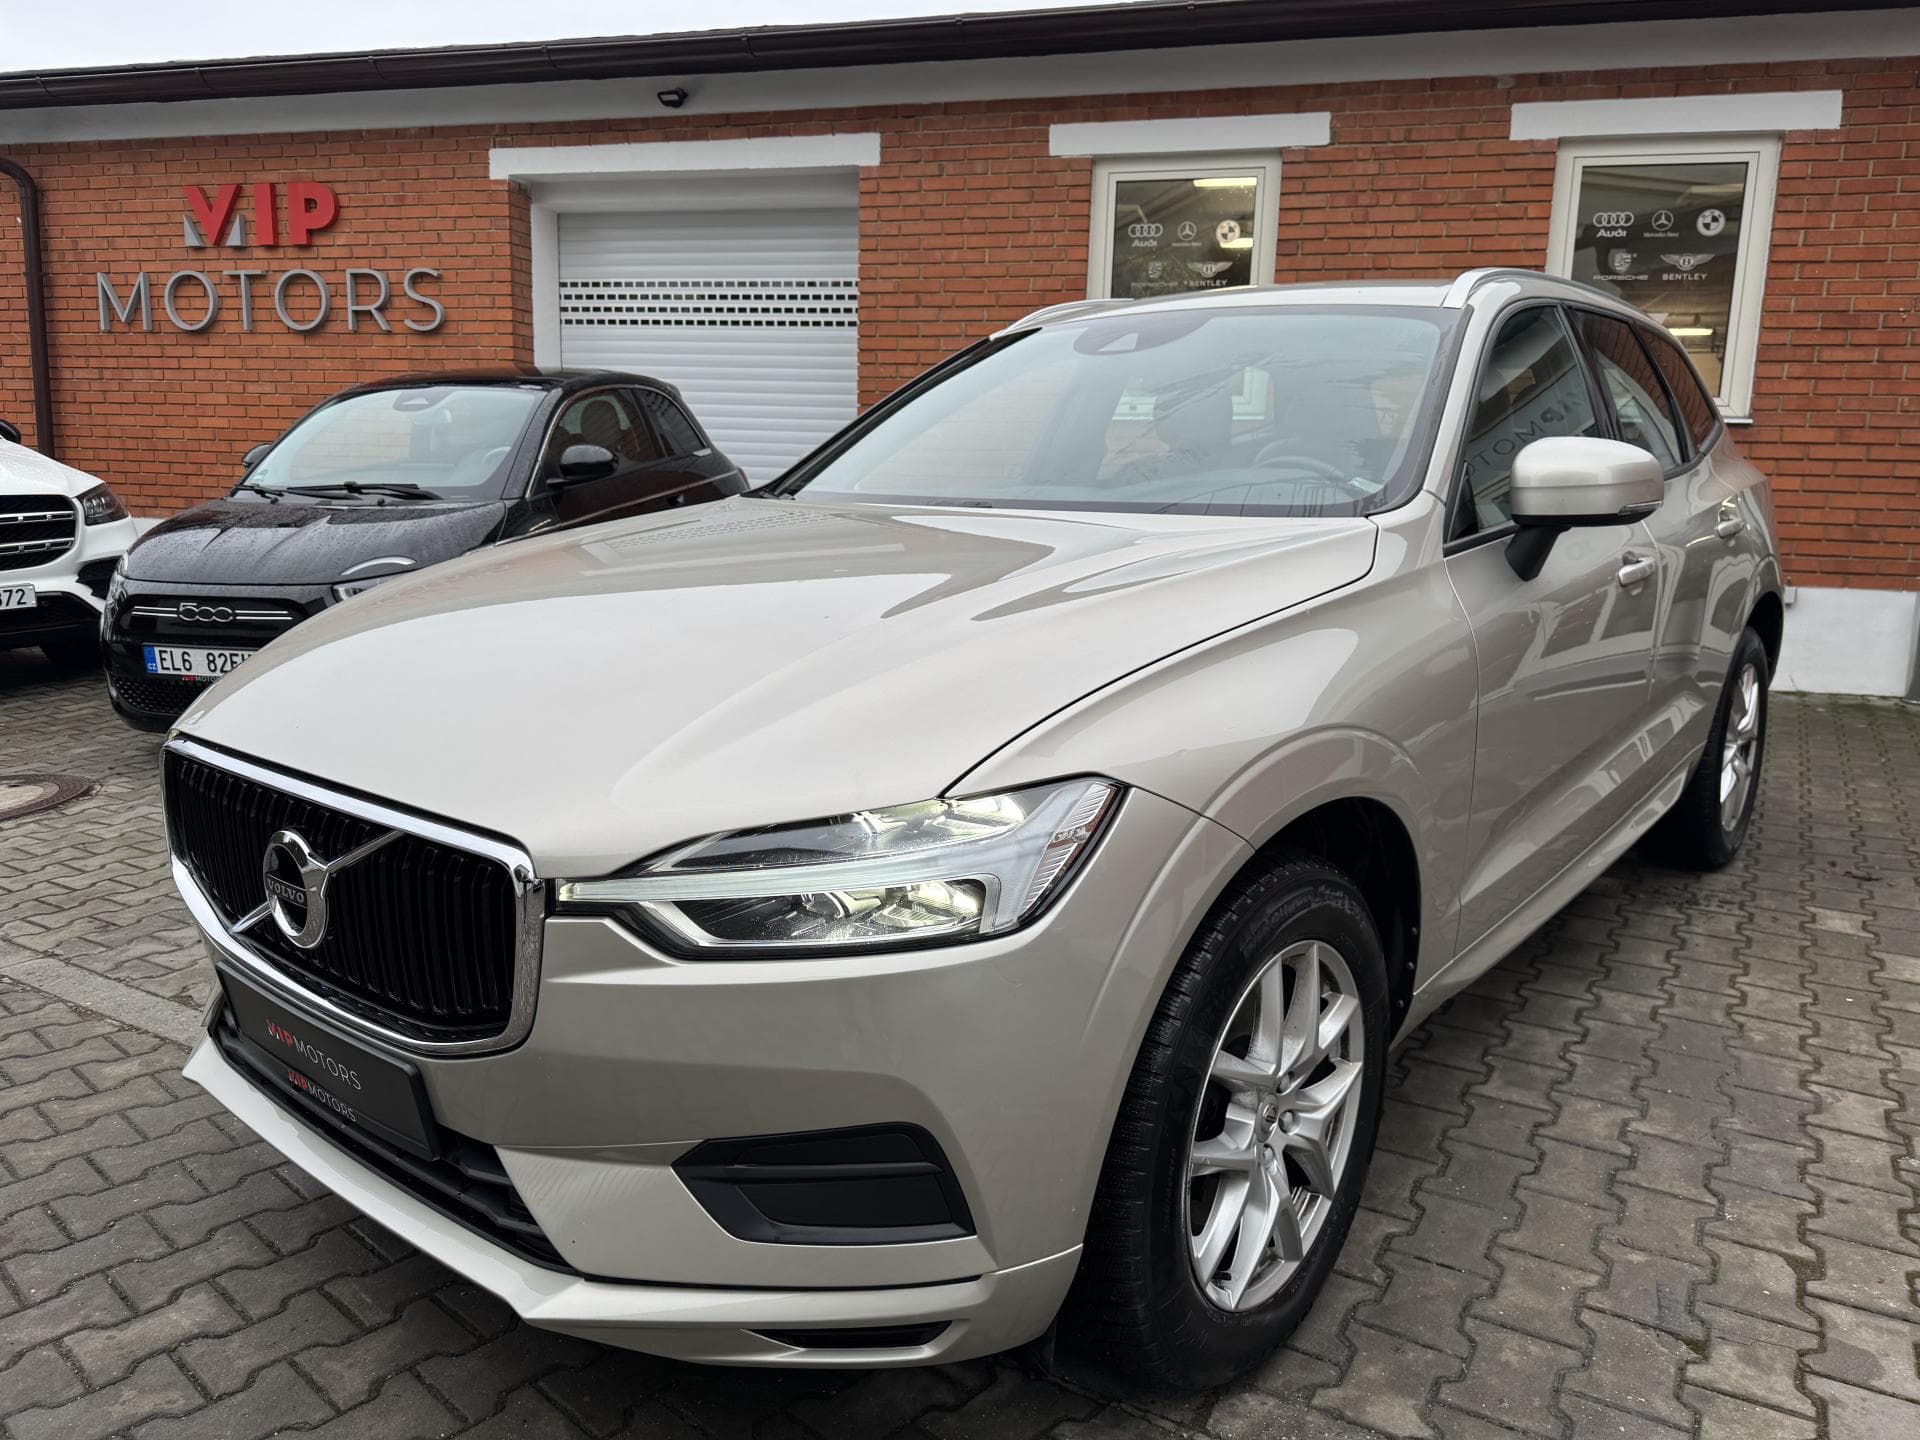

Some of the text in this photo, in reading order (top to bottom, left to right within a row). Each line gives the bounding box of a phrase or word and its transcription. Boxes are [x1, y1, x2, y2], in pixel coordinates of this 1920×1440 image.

[183, 181, 340, 248] VIP
[1596, 228, 1627, 238] Audi
[1131, 239, 1158, 248] Audi
[1188, 279, 1229, 288] BENTLEY
[1662, 273, 1708, 281] BENTLEY
[96, 267, 446, 333] MOTORS
[0, 588, 28, 607] 72
[179, 602, 234, 622] 500
[147, 663, 157, 671] CZ
[158, 650, 193, 672] EL6
[267, 878, 305, 904] VOLVO
